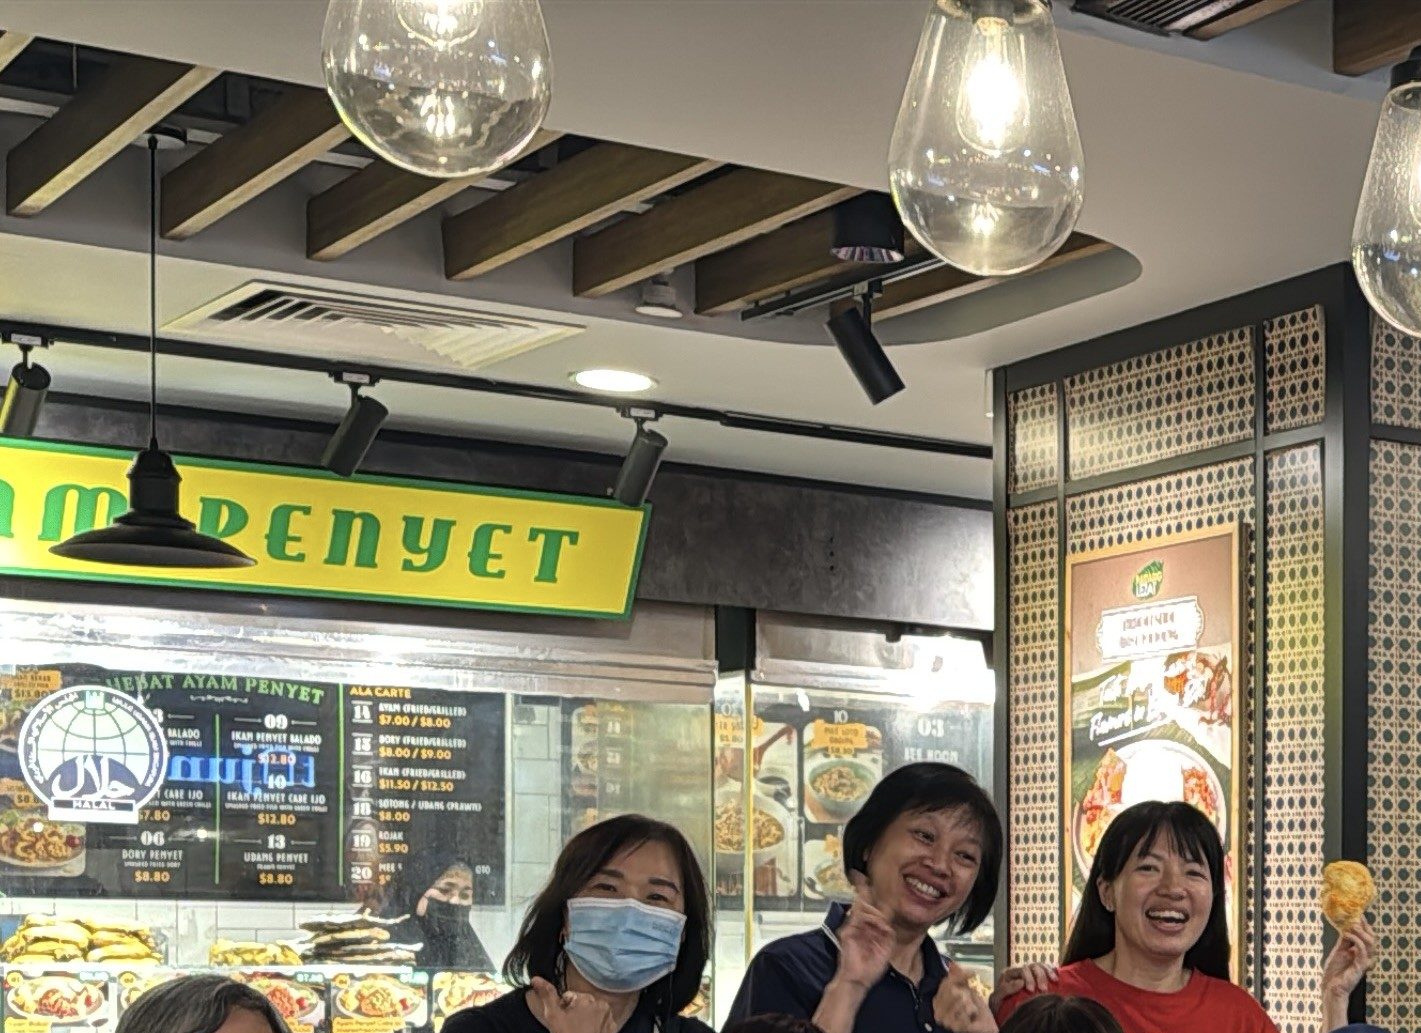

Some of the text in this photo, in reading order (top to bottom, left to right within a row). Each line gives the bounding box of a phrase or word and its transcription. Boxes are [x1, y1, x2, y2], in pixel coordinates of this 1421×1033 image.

[0, 479, 579, 583] M PENYET
[181, 676, 237, 691] AYAM
[245, 680, 324, 704] PENYET
[349, 686, 411, 699] ALA CARTE
[264, 714, 288, 729] 09
[379, 714, 410, 726] $7.00
[420, 717, 451, 729] $8.00
[918, 719, 945, 738] 03
[379, 747, 410, 758] $8.00
[420, 750, 451, 760] $9.00
[379, 779, 410, 790] $11.50
[421, 781, 454, 792] $12.50
[73, 800, 116, 810] HALAL
[257, 814, 296, 825] $12.80
[379, 811, 410, 822] $8.00
[140, 830, 165, 846] 06
[267, 834, 286, 849] 13
[134, 871, 171, 883] $8.80
[258, 873, 294, 885] $8.80
